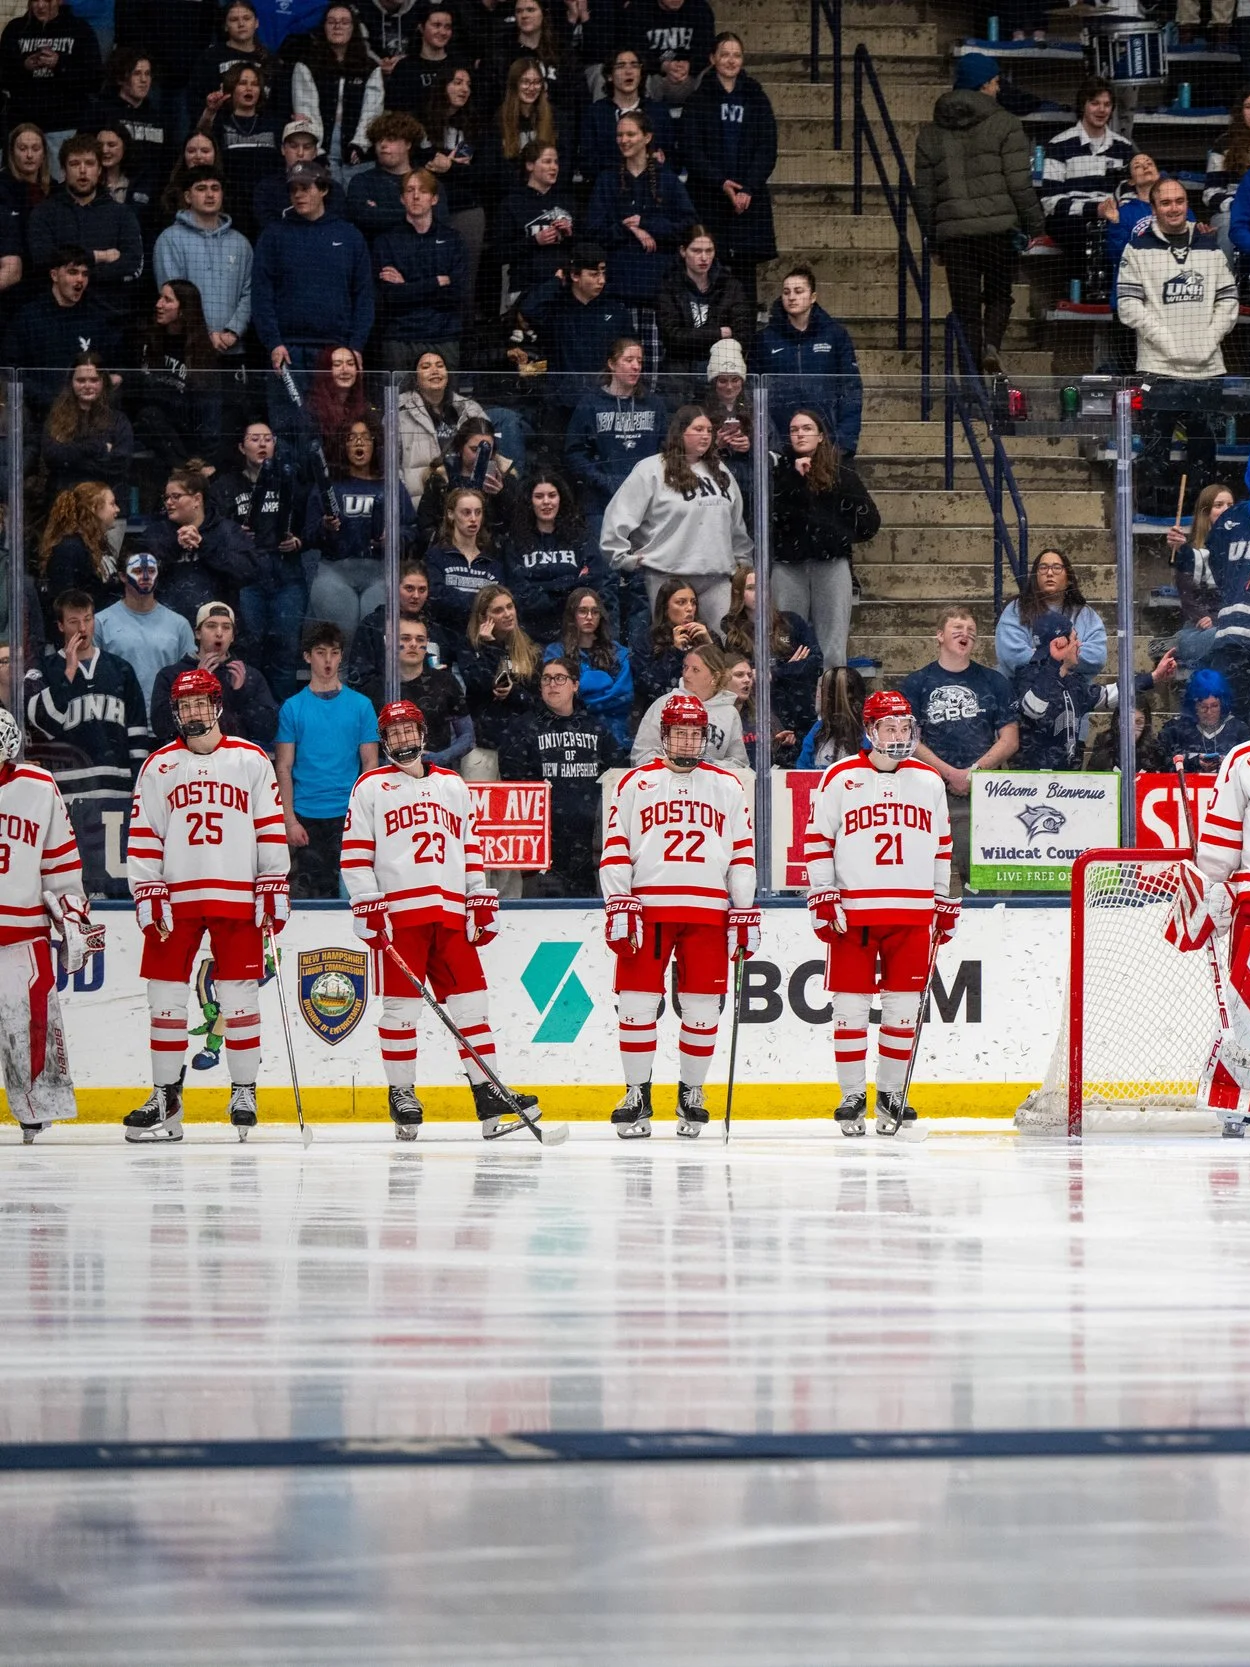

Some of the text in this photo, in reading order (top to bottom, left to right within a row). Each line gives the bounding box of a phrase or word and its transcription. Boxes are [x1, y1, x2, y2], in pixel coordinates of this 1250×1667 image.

[1133, 46, 1144, 75] YAMAHA
[1165, 283, 1204, 298] UNH
[1166, 295, 1204, 304] WILDCA
[342, 494, 377, 517] UN
[521, 549, 579, 568] UNH
[62, 692, 126, 732] UNH
[538, 731, 599, 755] UNIVERSITY
[565, 750, 575, 760] OF
[542, 762, 599, 778] NEW HAMPSHIRE
[984, 780, 1106, 800] Welcome Bienvenue
[504, 789, 545, 822] AVE
[188, 812, 224, 846] 25
[384, 801, 463, 840] BOSTON
[640, 799, 726, 838] BOSTON
[845, 802, 932, 837] BOSTON
[412, 831, 446, 865] 23
[481, 834, 542, 863] ERSITY
[663, 830, 706, 863] 22
[875, 832, 904, 865] 21
[980, 846, 1041, 861] Wildcat
[255, 881, 290, 893] BAUE
[996, 871, 1023, 882] LIVE
[1026, 871, 1055, 881] FREE
[466, 895, 499, 907] BAUE
[605, 902, 643, 914] BAUER
[807, 893, 841, 909] AUER
[934, 903, 961, 915] AUE
[729, 913, 761, 924] BAUE
[302, 951, 365, 966] NEW HAMPSHIRE
[302, 962, 365, 977] LIQUOR COMMISSION
[1207, 935, 1231, 1030] TRUE
[302, 998, 362, 1035] DIVISION OF ENFORCEMENT
[53, 1027, 68, 1076] BAUER
[1206, 1037, 1223, 1072] TRU
